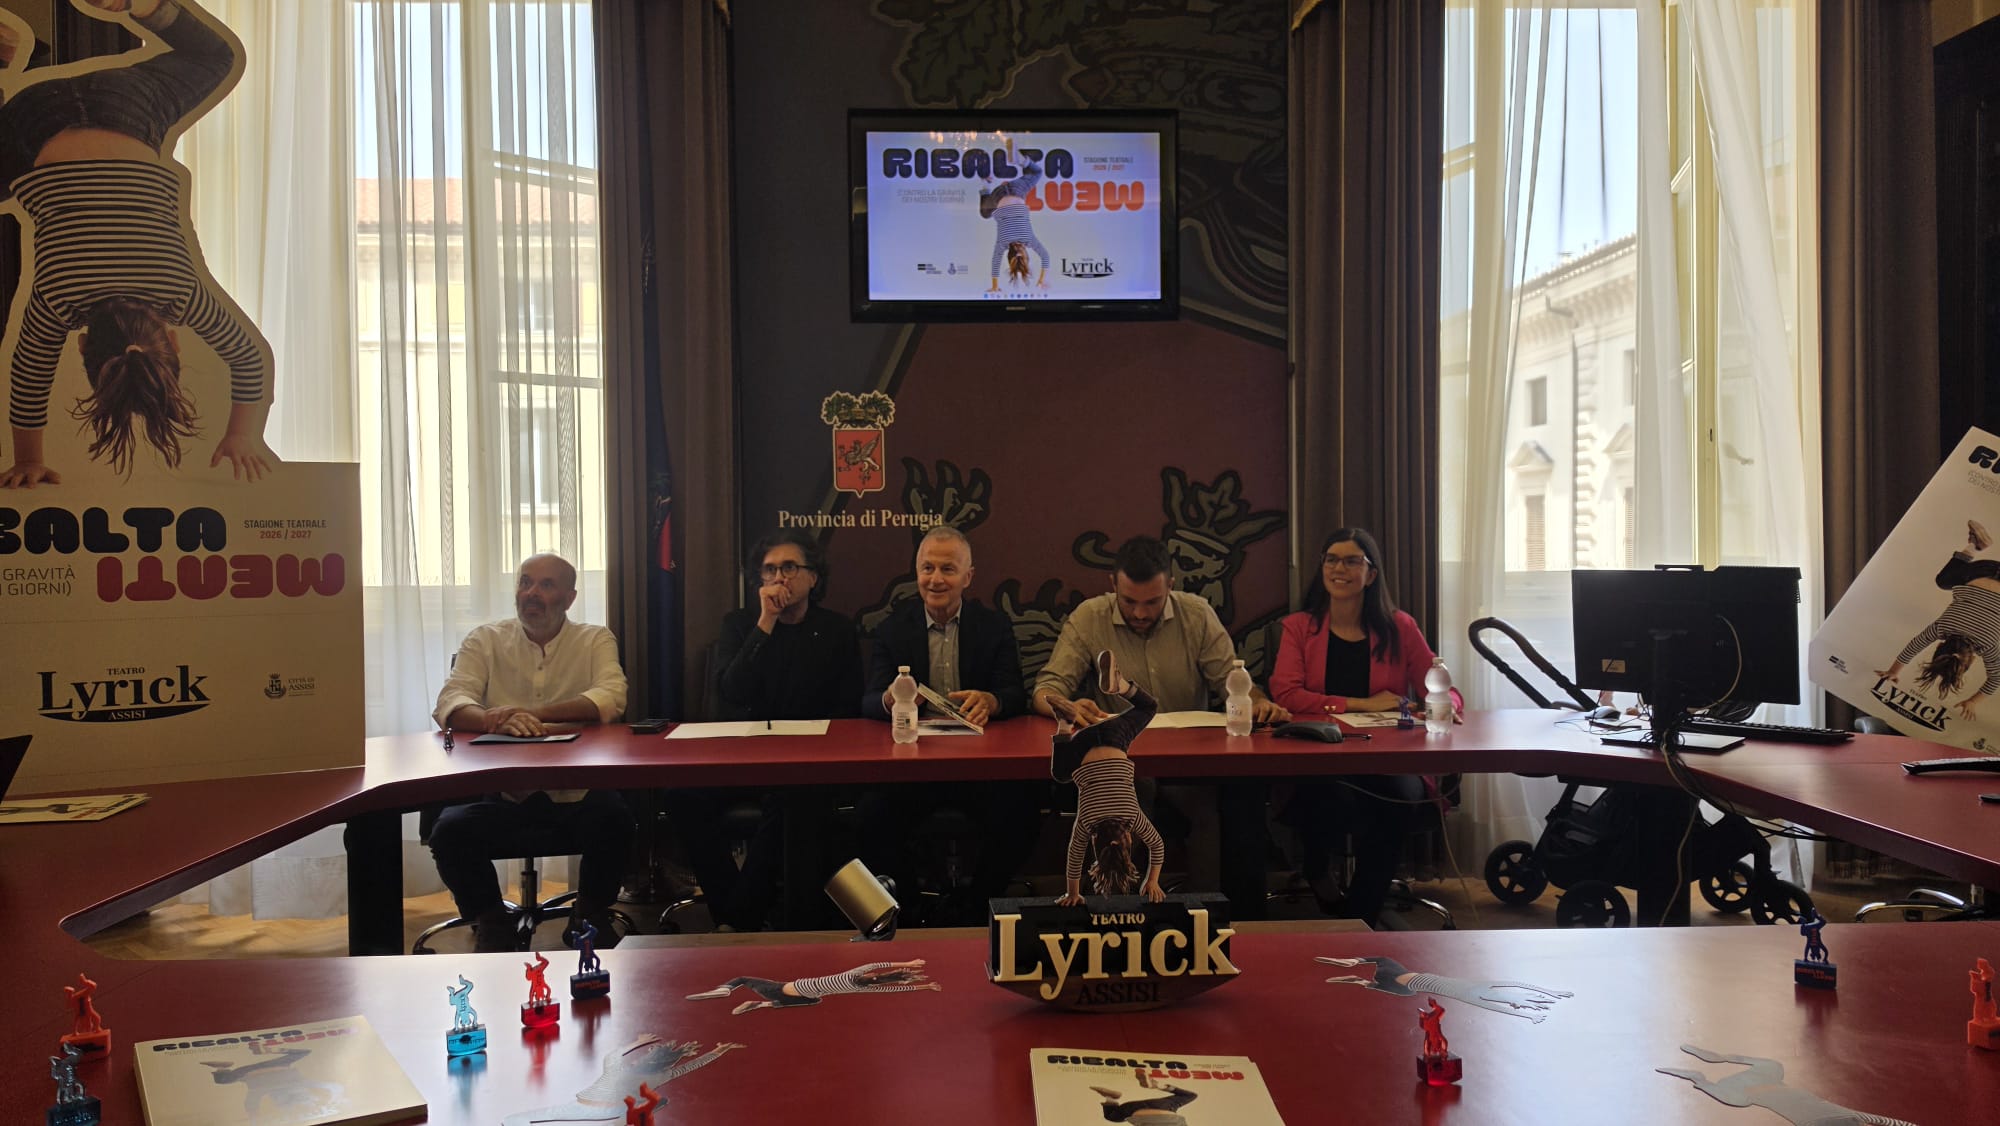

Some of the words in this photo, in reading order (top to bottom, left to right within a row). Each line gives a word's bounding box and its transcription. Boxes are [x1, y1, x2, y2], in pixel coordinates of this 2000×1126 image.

[1061, 258, 1114, 277] Lyrick
[244, 519, 285, 529] STAGIONE
[286, 519, 327, 529] TEATRALE
[778, 509, 856, 528] Provincia
[860, 509, 876, 527] di
[881, 508, 944, 531] Perugia
[260, 530, 282, 539] 2026
[291, 529, 312, 539] 2027
[3, 564, 76, 581] GRAVITÀ
[8, 580, 72, 597] GIORNI)
[107, 667, 145, 676] TEATRO
[36, 665, 211, 720] Lyrick
[1869, 674, 1953, 731] Lyrick
[108, 709, 146, 721] ASSISI
[1091, 912, 1145, 925] TEATRO
[993, 908, 1242, 1000] Lyrick
[1075, 981, 1161, 1005] ASSISI
